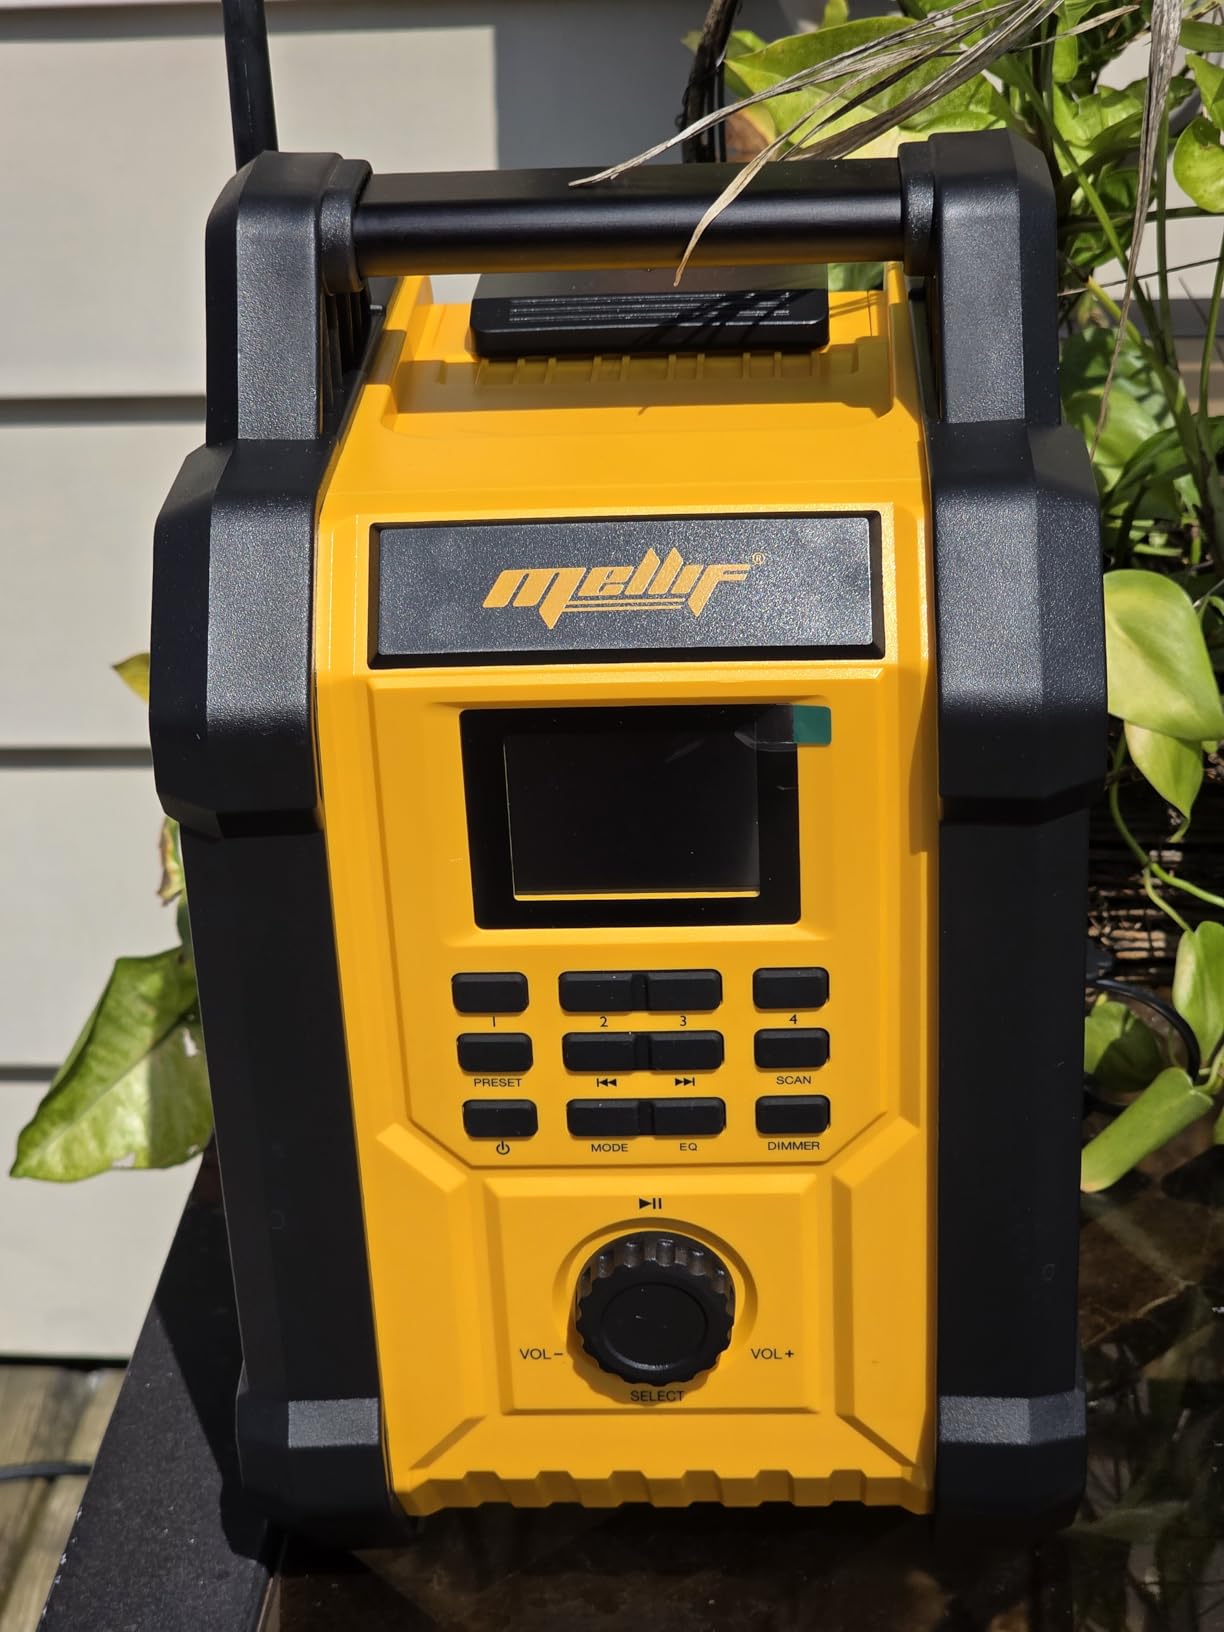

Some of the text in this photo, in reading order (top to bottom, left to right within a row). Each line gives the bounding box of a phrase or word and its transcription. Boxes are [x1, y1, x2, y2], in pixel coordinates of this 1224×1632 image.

[599, 1015, 608, 1028] 2
[679, 1015, 688, 1027] 3
[788, 1013, 799, 1025] 4
[473, 1077, 523, 1088] PRESET
[775, 1074, 813, 1086] SCAN
[590, 1142, 629, 1153] MODE
[678, 1142, 699, 1152] EQ
[766, 1140, 821, 1151] DIMMER
[630, 1389, 685, 1402] SELECT
